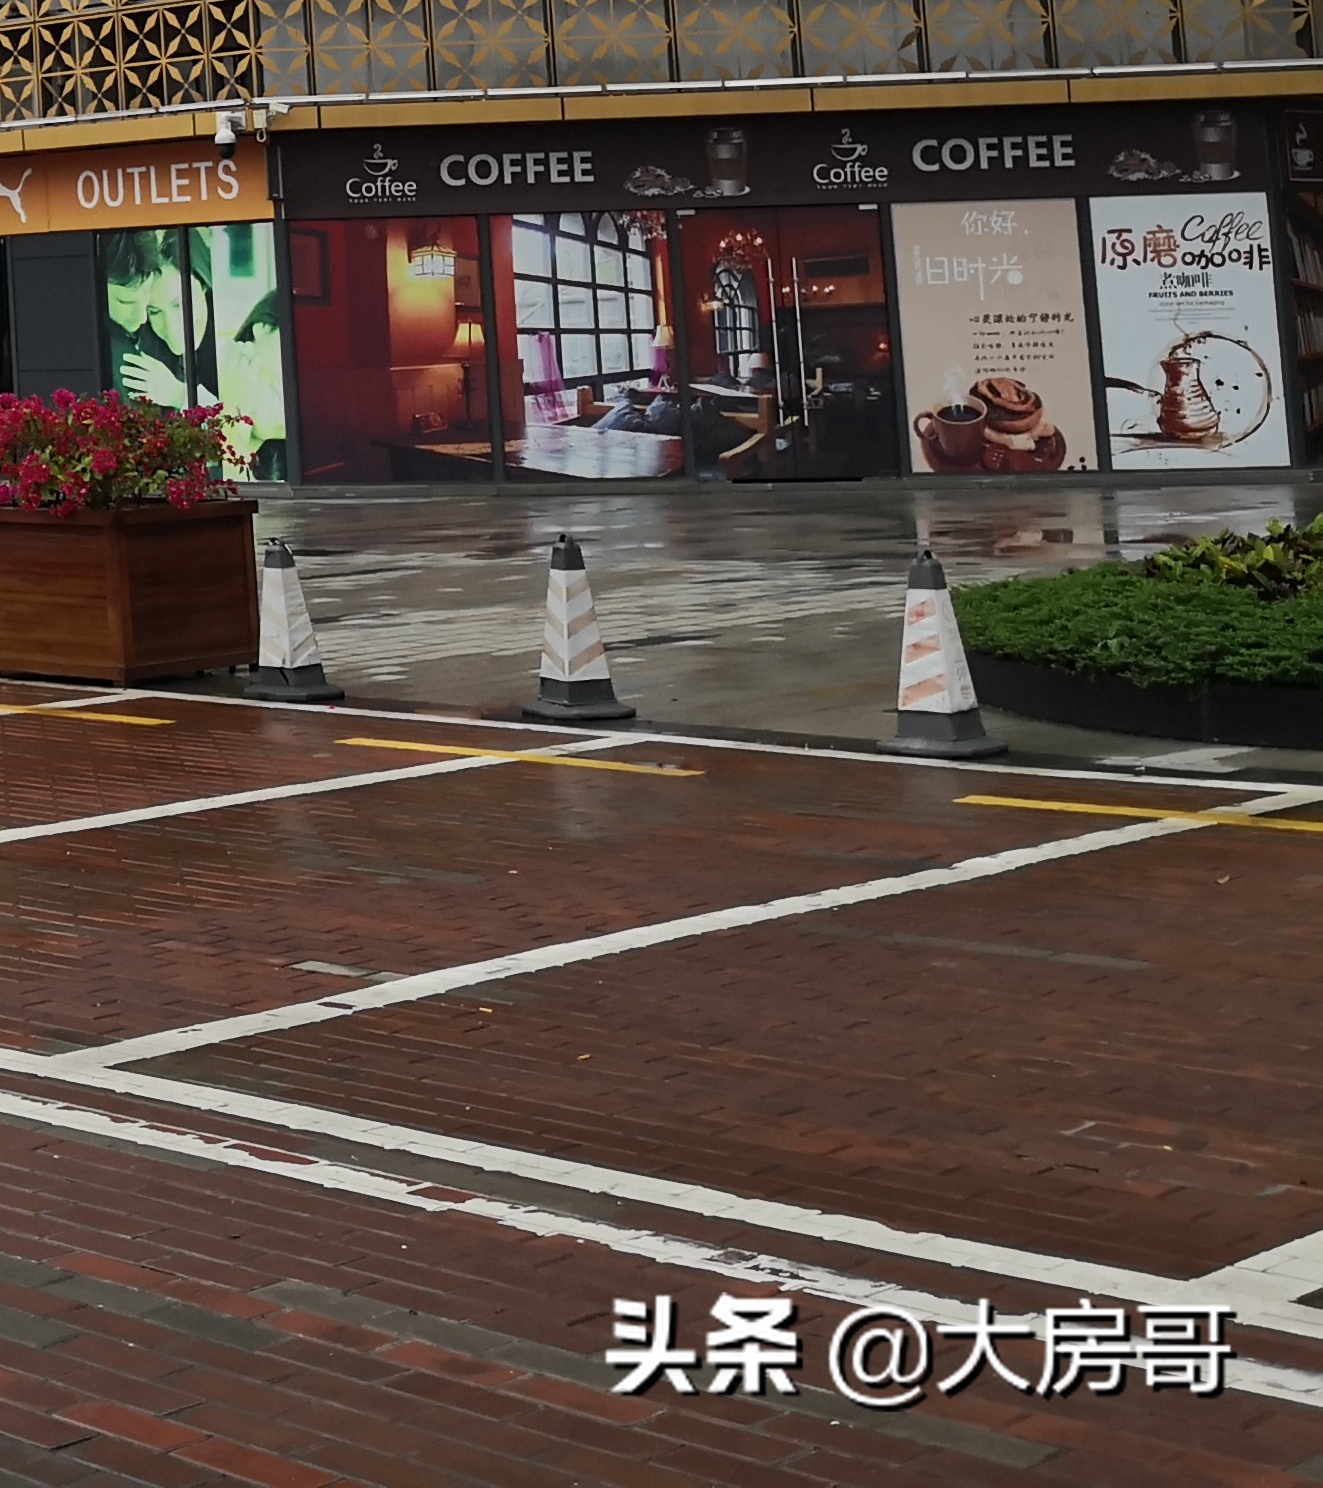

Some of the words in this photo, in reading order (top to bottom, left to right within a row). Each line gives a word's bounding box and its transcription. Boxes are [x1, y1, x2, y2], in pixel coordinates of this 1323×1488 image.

[439, 150, 595, 187] COFFEE
[912, 134, 1075, 173] COFFEE
[77, 160, 240, 210] OUTLETS
[346, 176, 417, 198] Coffee
[813, 162, 889, 184] Coffee
[1180, 211, 1264, 254] Coffee
